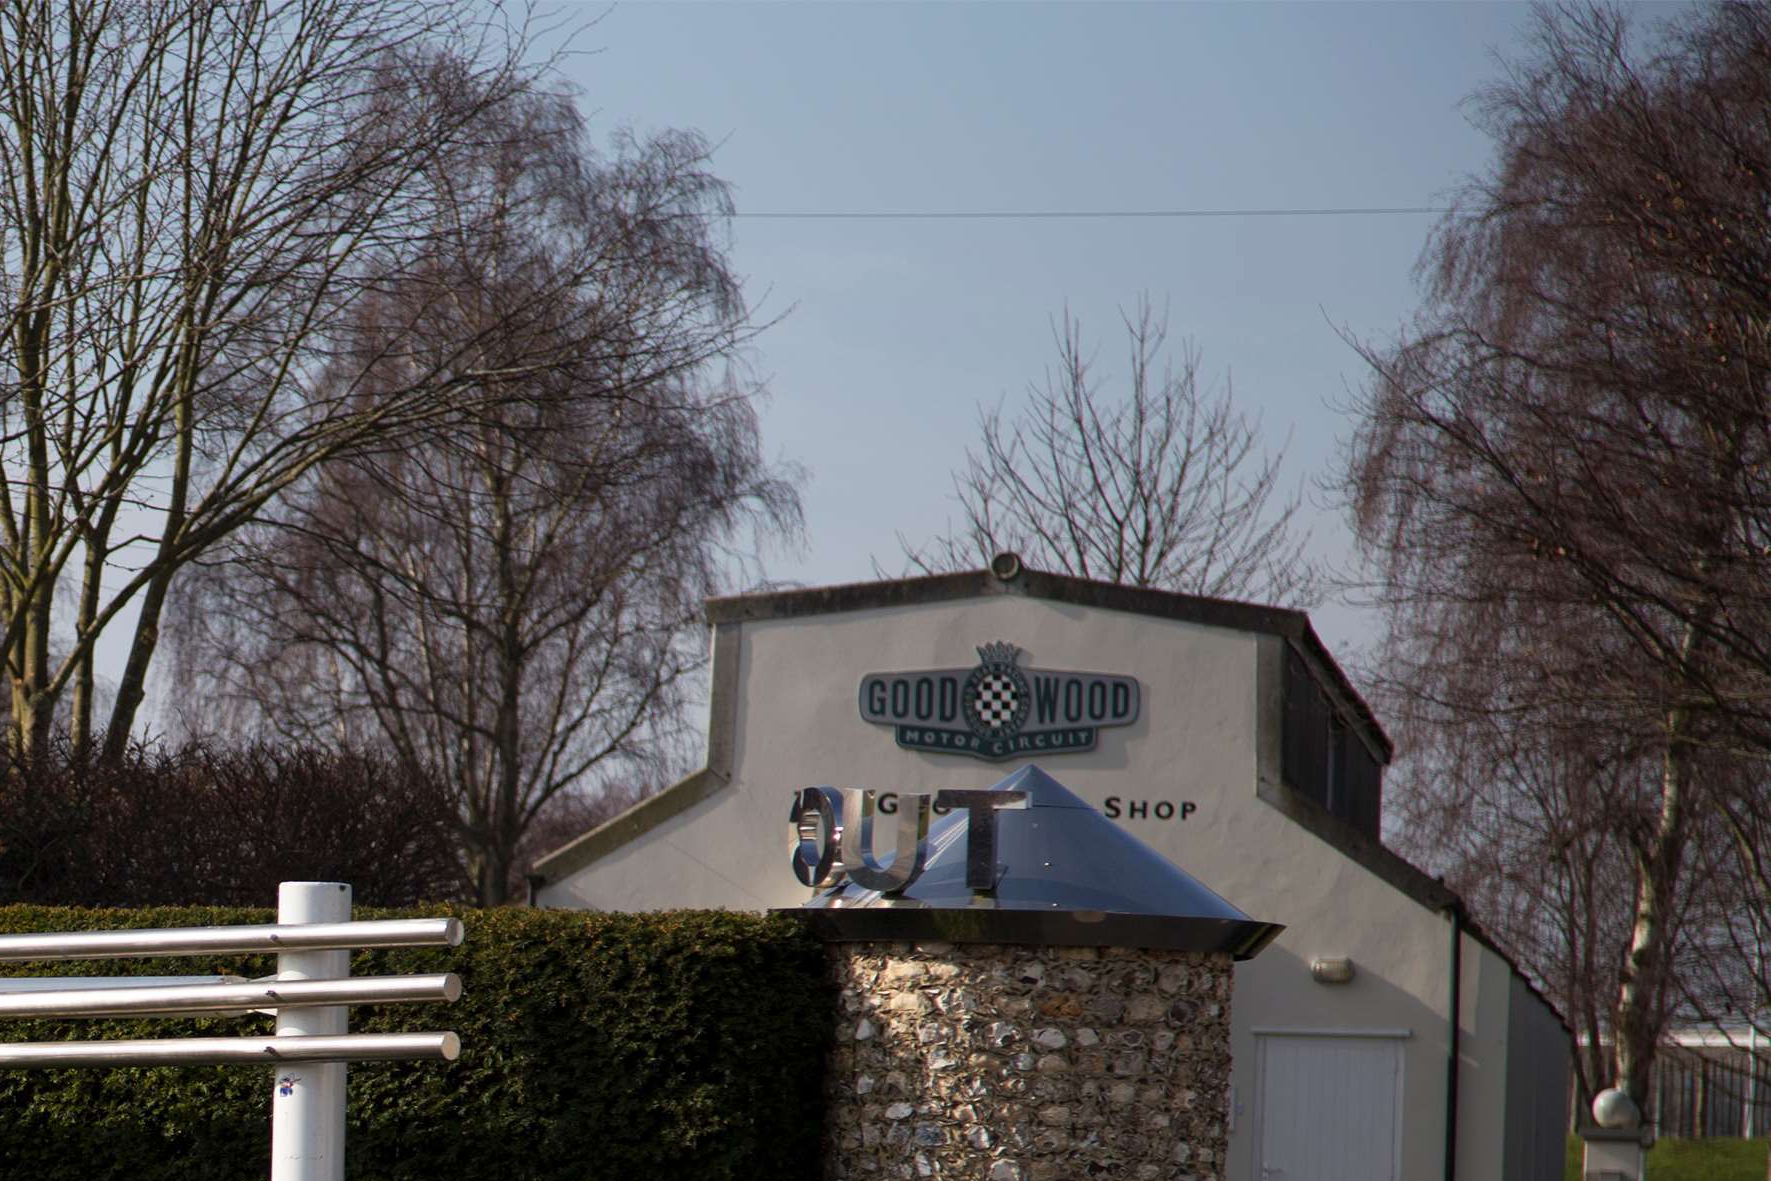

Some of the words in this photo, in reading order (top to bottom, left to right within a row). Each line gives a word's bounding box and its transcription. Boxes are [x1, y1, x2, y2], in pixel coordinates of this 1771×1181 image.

[868, 677, 958, 722] GOOD
[1034, 676, 1128, 724] WOOD
[905, 729, 978, 749] MOTOR
[993, 730, 1089, 753] CIRCUIT
[1104, 796, 1197, 820] SHOP
[788, 786, 1032, 890] OUT
